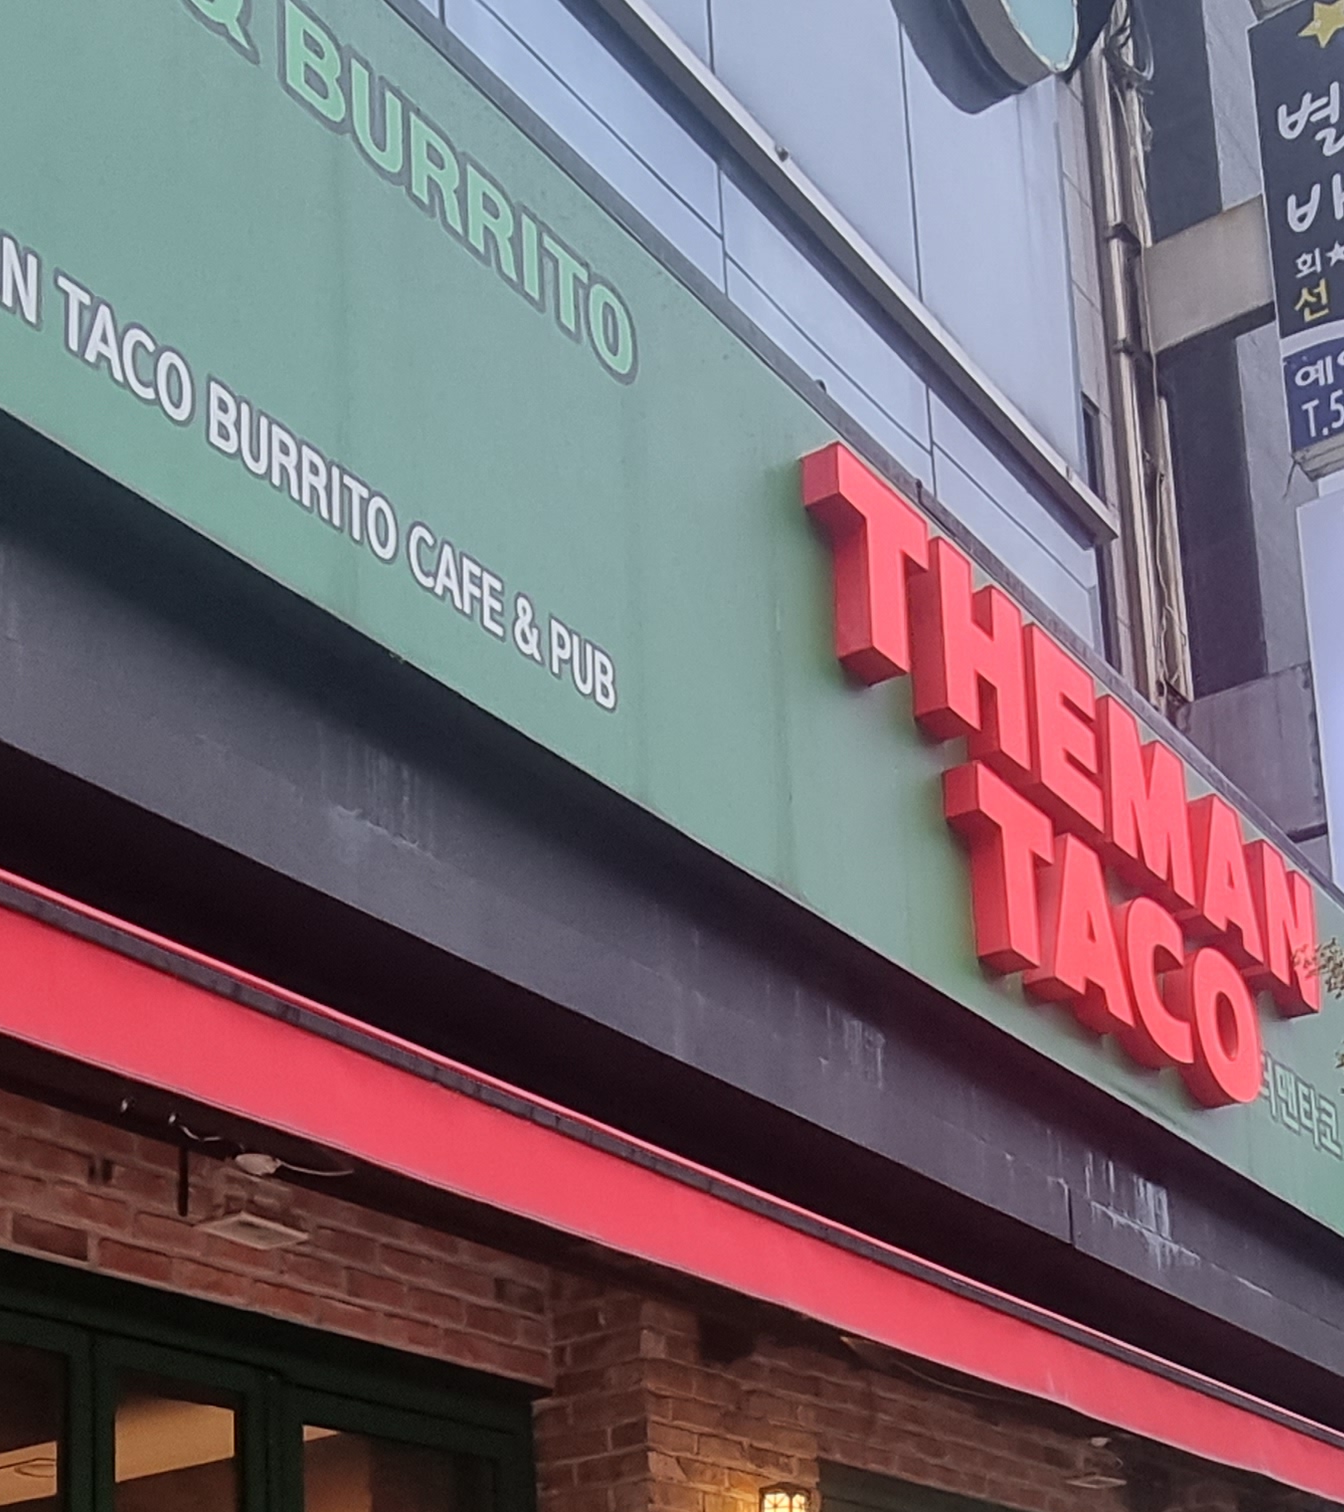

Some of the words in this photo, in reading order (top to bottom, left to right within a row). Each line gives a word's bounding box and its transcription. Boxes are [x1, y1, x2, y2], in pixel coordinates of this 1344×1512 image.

[282, 1, 638, 380] BURRITO
[56, 273, 195, 423] TACO
[207, 377, 397, 560] BURRITO
[408, 523, 504, 637] CAFE
[514, 598, 543, 660] &
[549, 629, 617, 711] PUB
[944, 760, 1261, 1109] TACO
